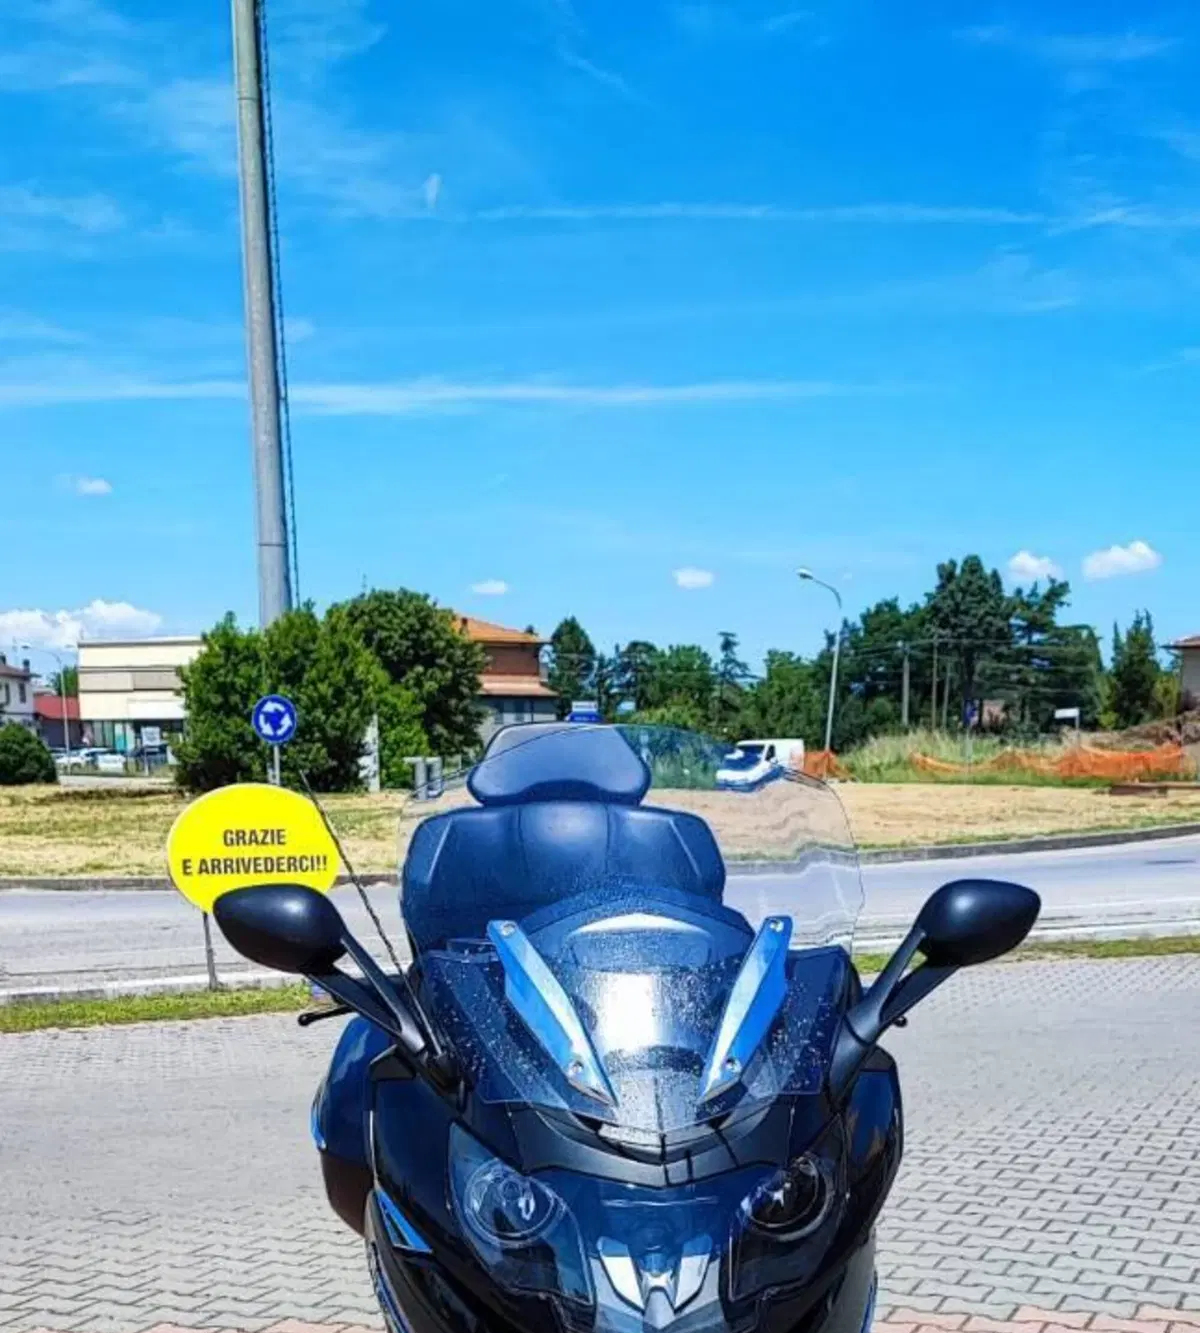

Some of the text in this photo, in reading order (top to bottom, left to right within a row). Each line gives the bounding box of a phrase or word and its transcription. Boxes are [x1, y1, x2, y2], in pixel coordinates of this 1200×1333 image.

[223, 829, 286, 846] GRAZIE
[182, 855, 327, 875] E ARRIVEDERCI!!
